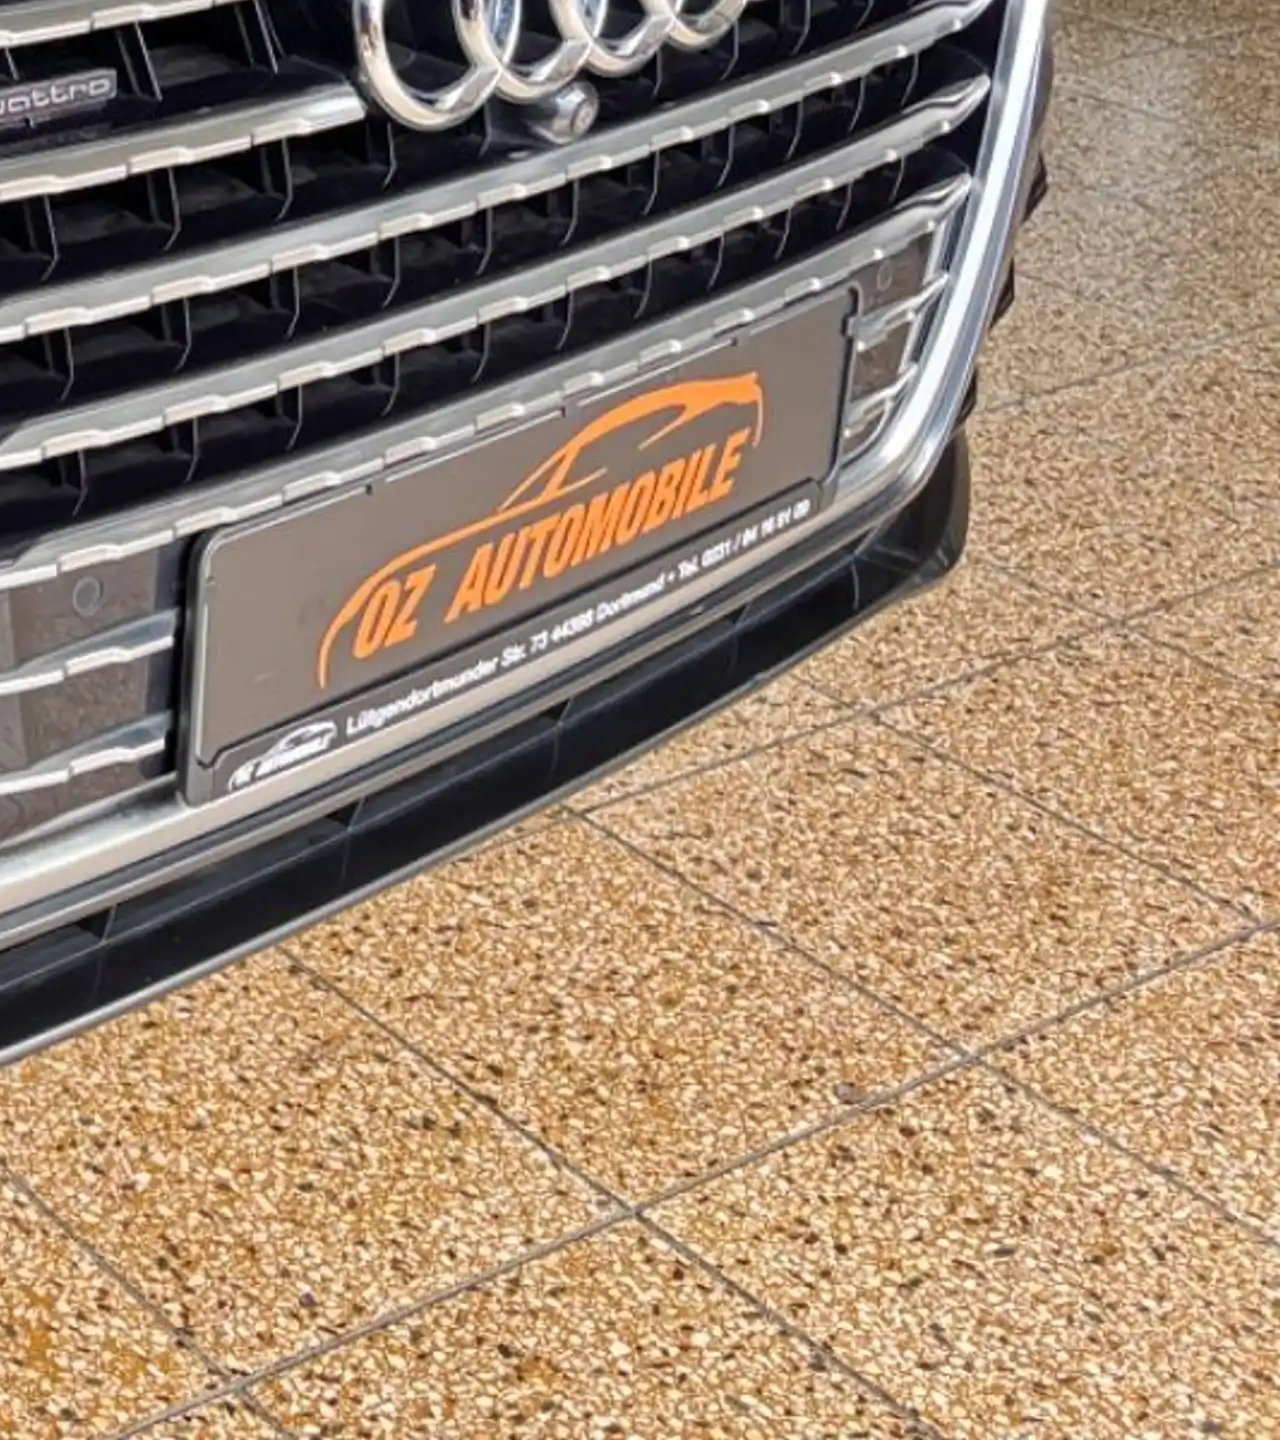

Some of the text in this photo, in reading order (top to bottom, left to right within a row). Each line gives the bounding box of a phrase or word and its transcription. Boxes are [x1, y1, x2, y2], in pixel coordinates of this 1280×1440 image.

[352, 428, 751, 660] OZ AUTOMOBILE
[595, 571, 667, 623] Dortmund
